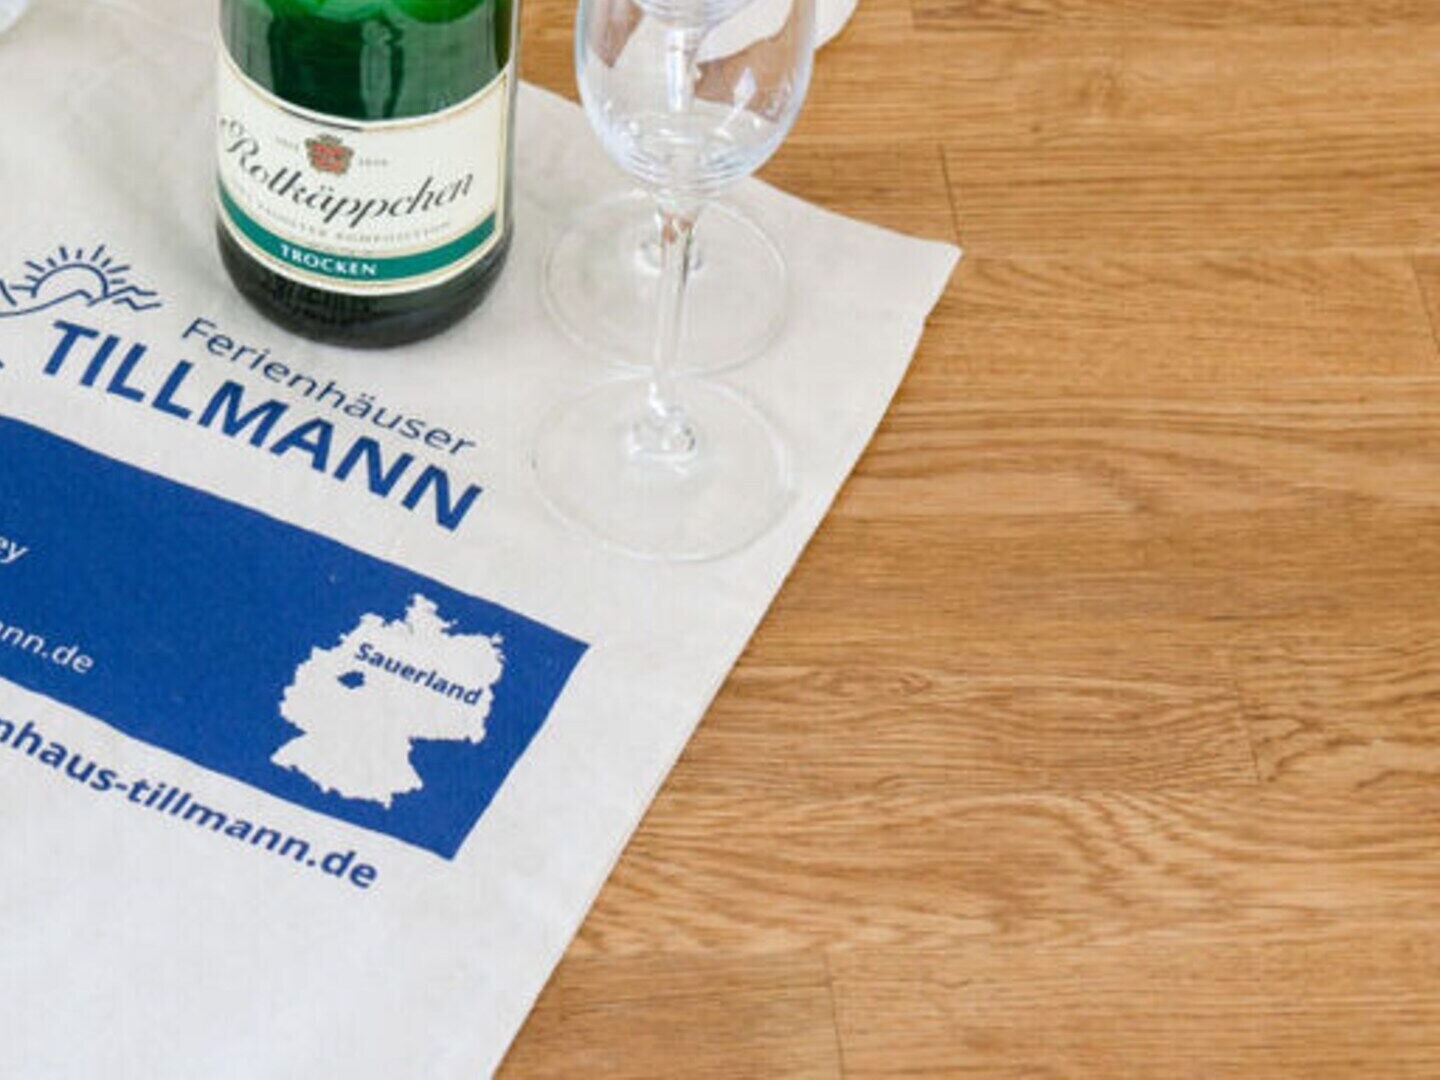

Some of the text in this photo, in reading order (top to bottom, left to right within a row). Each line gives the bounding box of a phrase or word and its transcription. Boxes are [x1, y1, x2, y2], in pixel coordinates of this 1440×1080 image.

[219, 117, 474, 229] Rotkäppchen
[278, 242, 378, 277] TROCKEN
[42, 320, 484, 533] TILLMANN
[181, 317, 477, 457] Ferienhäuser
[354, 642, 483, 706] Sauerland
